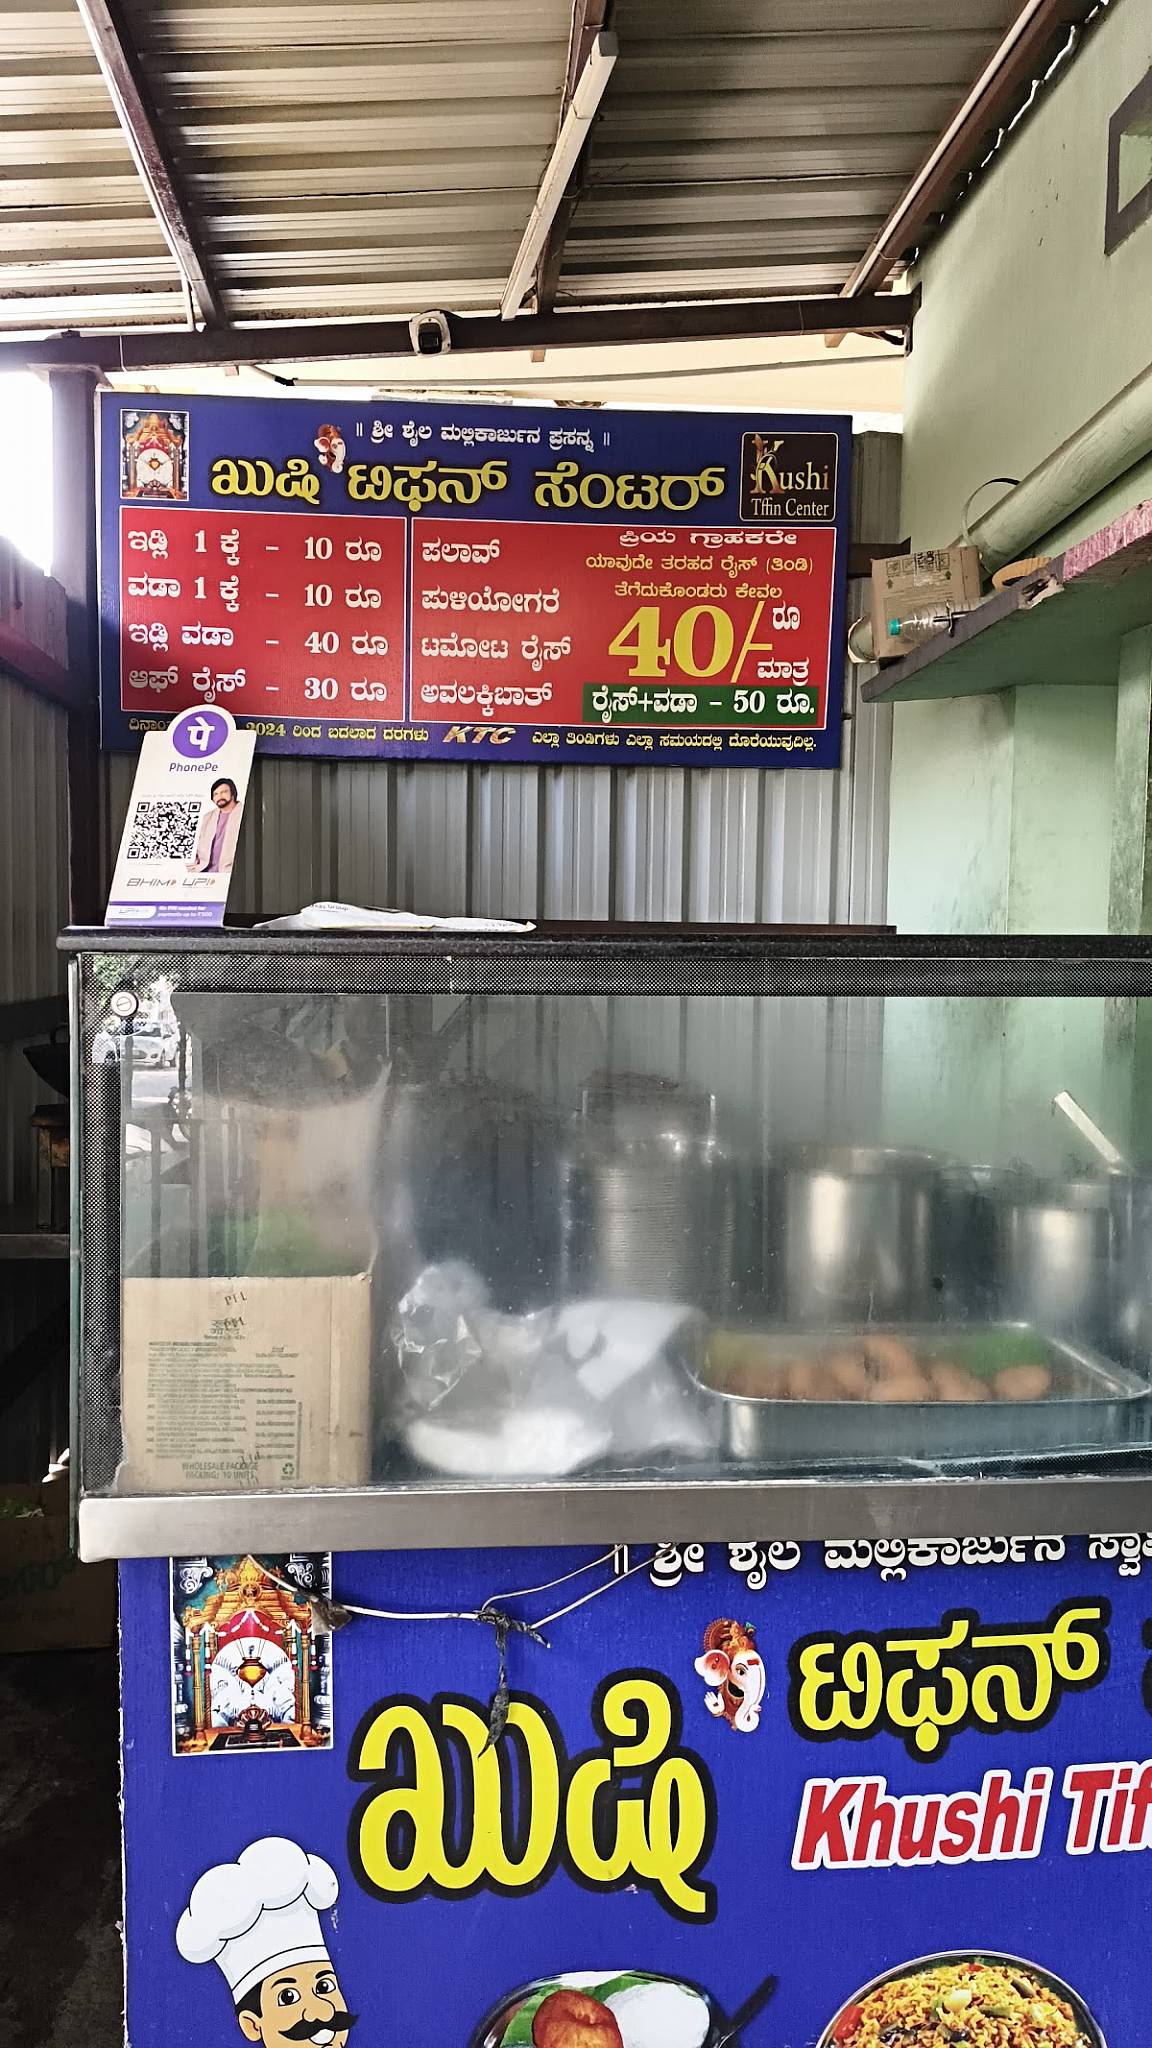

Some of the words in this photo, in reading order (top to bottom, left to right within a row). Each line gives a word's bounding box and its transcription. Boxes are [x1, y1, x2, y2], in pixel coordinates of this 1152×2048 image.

[371, 420, 393, 443] ಶ್ರೀ
[402, 420, 432, 447] ಶೈಲ
[441, 423, 541, 447] ಮಲ್ಲಿಕಾರ್ಜುನ
[549, 428, 595, 452] ಪ್ರಸನ್ನ
[750, 433, 830, 494] Kushi
[211, 459, 321, 505] ಖುಷಿ
[347, 460, 508, 512] ಟಿಫನ್
[534, 461, 726, 511] ಸೆಂಟರ್
[785, 498, 830, 516] Center
[128, 529, 168, 560] ಇಡ್ಲಿ
[194, 529, 207, 553] 1
[220, 528, 241, 566] ಕ್ಕೆ
[304, 536, 333, 560] 10
[345, 536, 382, 562] ರೂ
[421, 536, 501, 565] ಪಲಾವ್
[619, 529, 676, 547] ಪ್ರಿಯ
[690, 530, 798, 549] ಗ್ರಾಹಕರೇ
[586, 552, 653, 572] ಯಾವುದೇ
[661, 554, 713, 571] ತರಹದ
[721, 555, 758, 579] ರೈಸ್
[766, 557, 813, 576] (ತಿಂಡಿ)
[128, 571, 181, 598] ವಡಾ
[194, 576, 207, 599] 1
[219, 575, 241, 613] ಕ್ಕೆ
[304, 583, 333, 607] 10
[345, 583, 382, 608] ರೂ
[421, 585, 560, 614] ಪುಳಿಯೋಗರೆ
[614, 581, 728, 598] ತೆಗೆದುಕೊಂಡರು
[735, 582, 783, 599] ಕೇವಲ
[772, 600, 801, 630] ರೂ
[128, 622, 169, 653] ಇಡ್ಲಿ
[181, 621, 234, 647] ವಡಾ
[304, 631, 340, 654] 40
[351, 631, 389, 656] ರೂ
[421, 632, 508, 659] ಟಮೋಟ
[521, 634, 571, 672] ರೈಸ್
[192, 666, 246, 703] ರೈಸ್
[304, 677, 339, 700] 30
[350, 677, 387, 702] ರೂ
[757, 657, 810, 687] ಮಾತ್ರ
[420, 680, 553, 717] ಅವಲಕ್ಕಿಬಾತ್
[733, 690, 765, 714] 50
[776, 688, 815, 714] ರೂ.
[129, 718, 170, 731] ದಿನಾಂ
[292, 725, 322, 740] ರಿಂದ
[328, 726, 377, 741] ಬದಲಾದ
[383, 728, 429, 742] ದರಗಳು
[442, 726, 516, 744] KTC
[532, 731, 560, 748] ಎಲ್ಲಾ
[566, 732, 620, 746] ತಿಂಡಿಗಳು
[626, 733, 654, 751] ಎಲ್ಲಾ
[659, 733, 723, 751] ಸಮಯದಲ್ಲಿ
[169, 762, 219, 772] PhonePe
[127, 877, 171, 887] BHIM
[182, 878, 211, 887] UPI
[1088, 1532, 1152, 1577] ಸ್ವಾ
[358, 1679, 706, 1914] ಖುಷಿ
[799, 1608, 1101, 1752] ಟಿಫನ್
[797, 1771, 1048, 1865] Khushi
